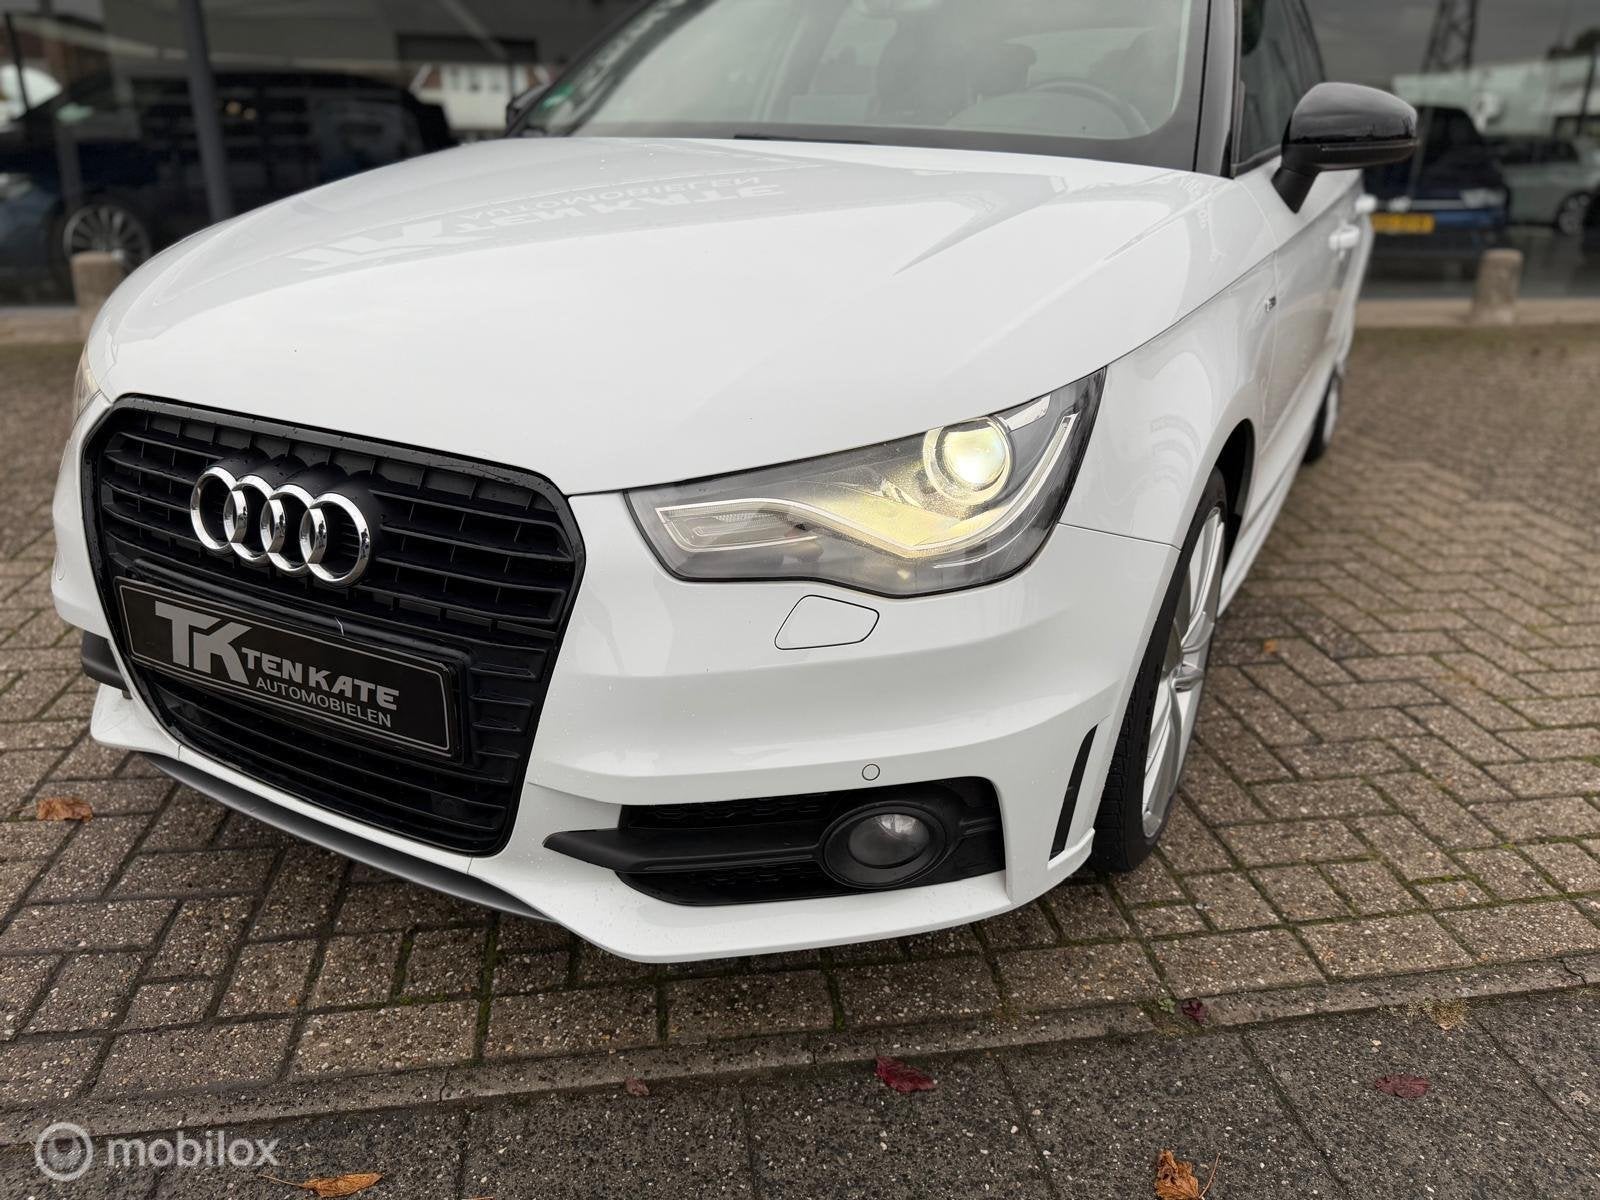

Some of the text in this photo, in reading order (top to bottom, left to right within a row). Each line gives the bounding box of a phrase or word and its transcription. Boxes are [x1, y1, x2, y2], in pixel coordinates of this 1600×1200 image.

[155, 600, 252, 685] TK
[242, 647, 400, 711] TEN KATE
[256, 676, 392, 728] AUTOMOBIELEN
